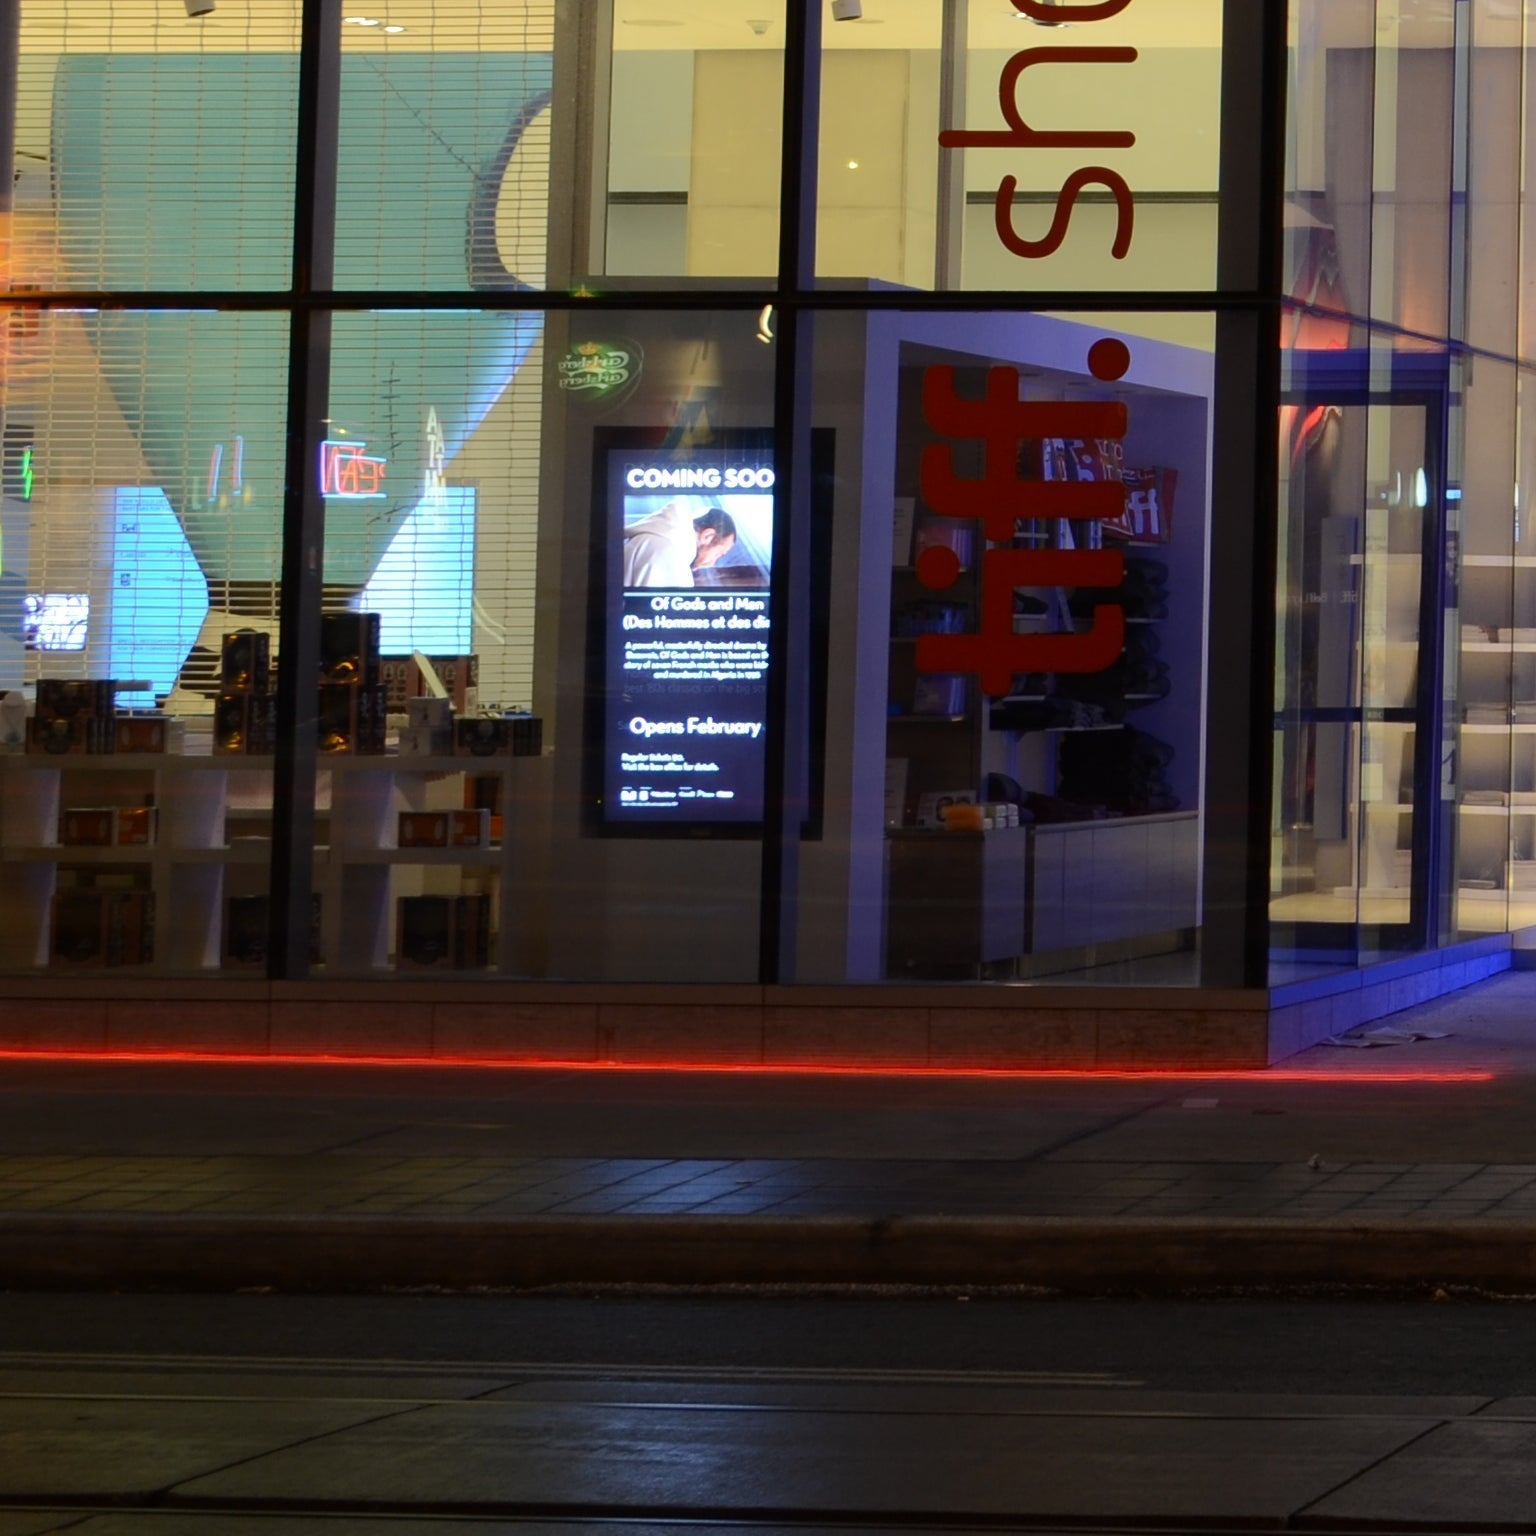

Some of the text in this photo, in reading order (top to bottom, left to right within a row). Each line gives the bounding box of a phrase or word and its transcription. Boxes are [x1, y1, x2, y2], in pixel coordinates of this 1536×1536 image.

[627, 468, 721, 489] COMING
[915, 338, 1132, 697] tiff.
[651, 596, 764, 611] Of Gods and Men
[655, 614, 710, 630] Hommes
[727, 614, 752, 630] des
[629, 716, 762, 738] Opens February
